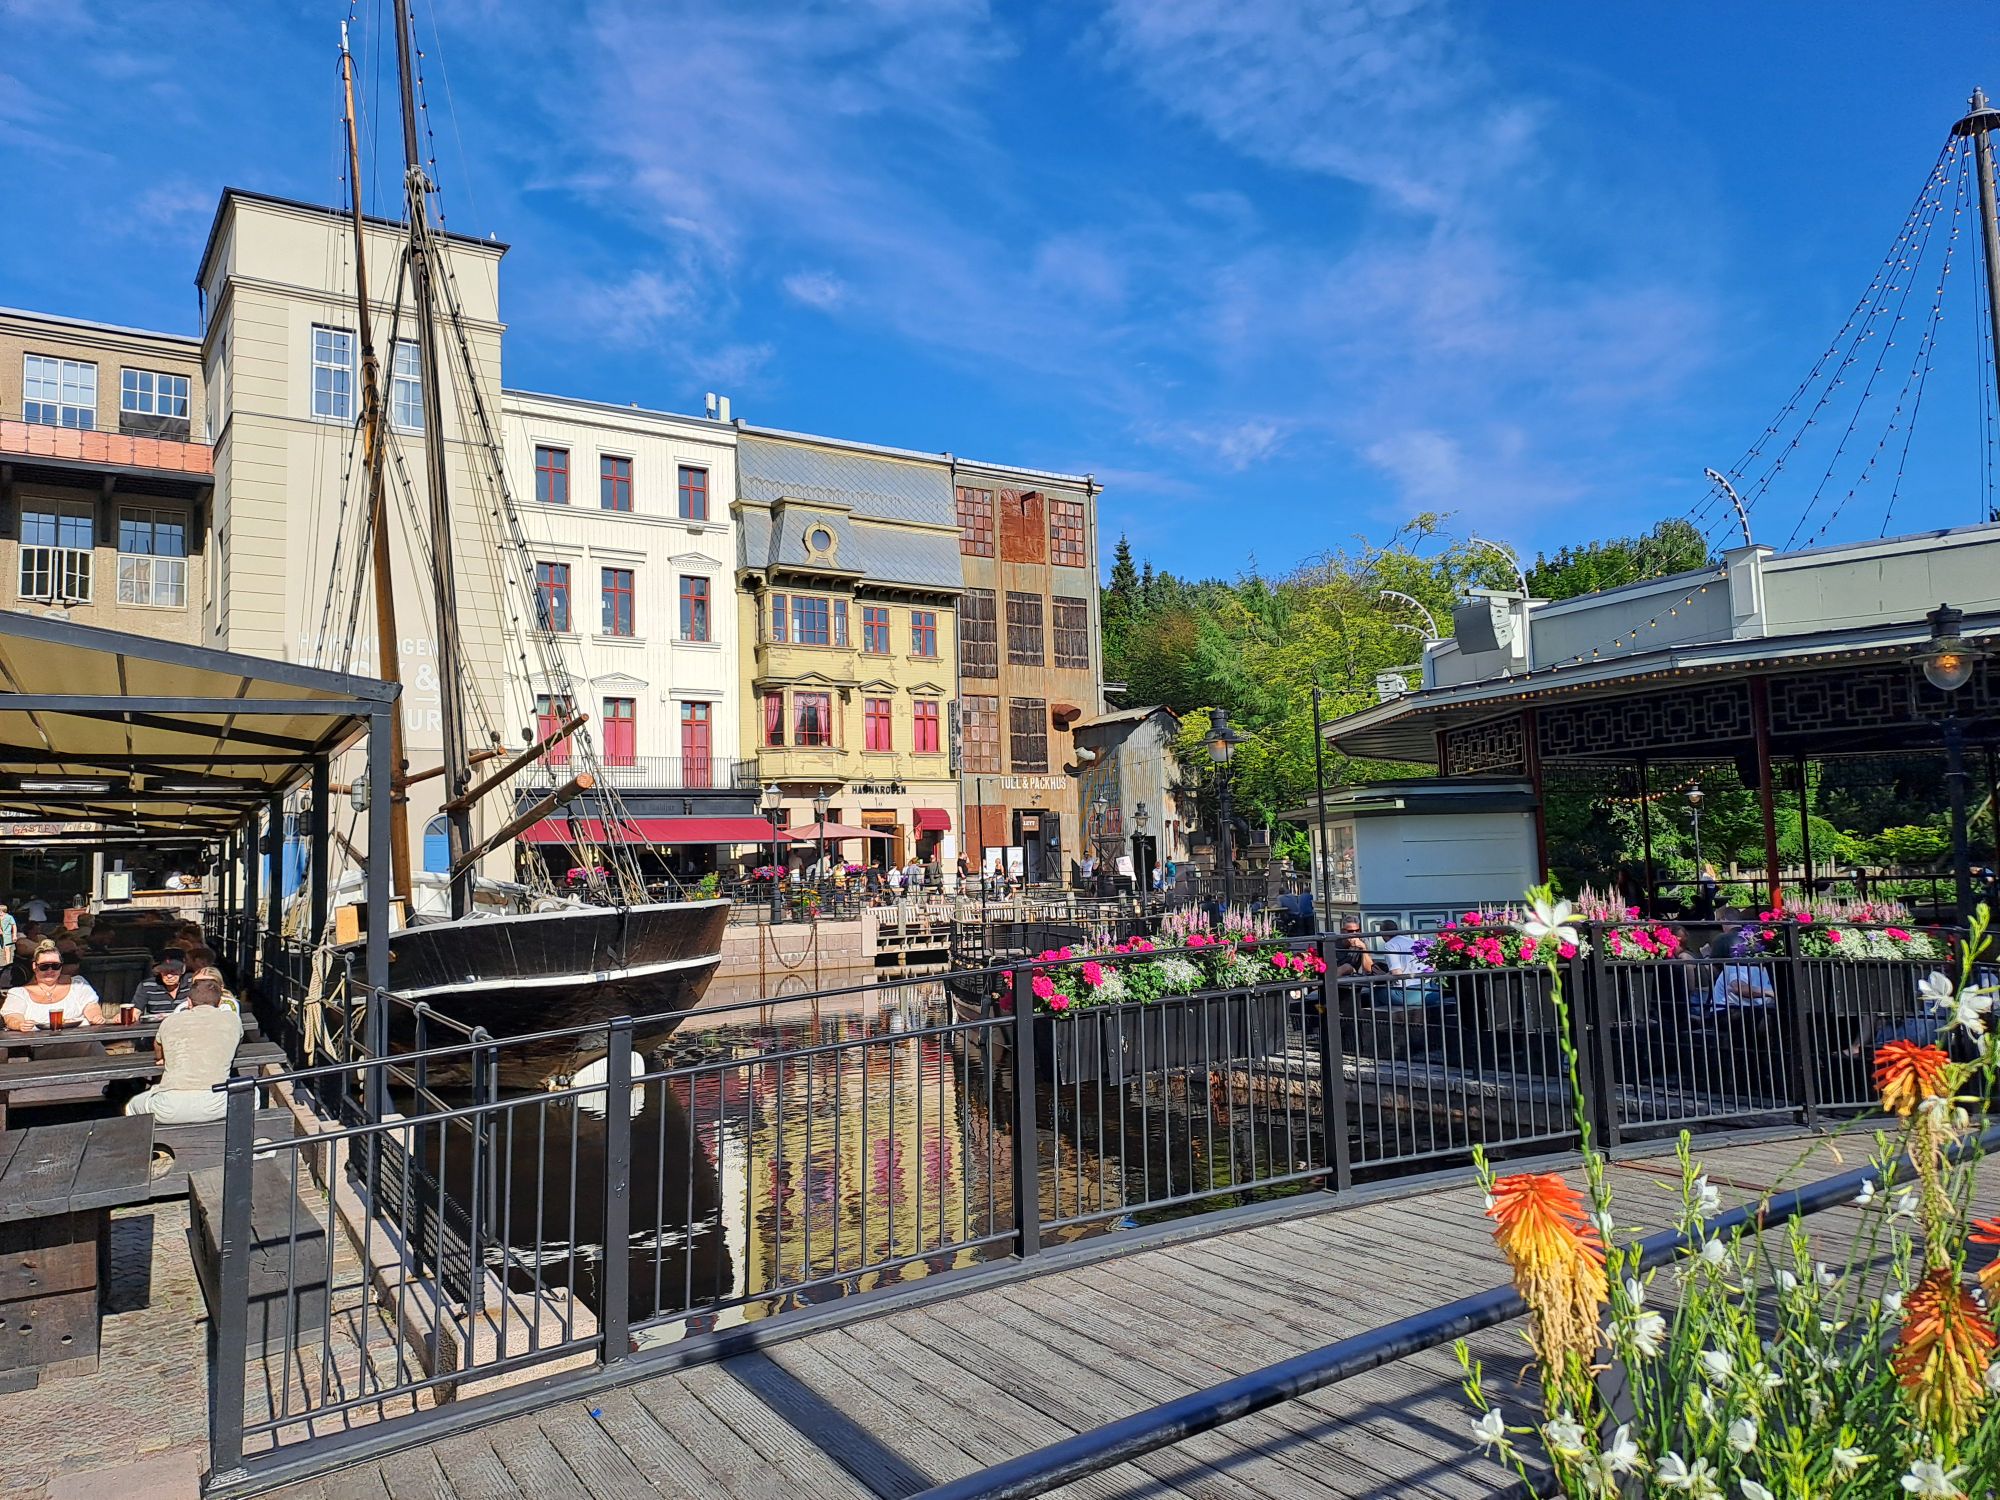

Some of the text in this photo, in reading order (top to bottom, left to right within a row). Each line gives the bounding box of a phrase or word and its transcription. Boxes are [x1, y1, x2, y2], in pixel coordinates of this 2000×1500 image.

[999, 776, 1067, 790] TULL & PACKHUS
[852, 785, 907, 795] HANKROEN
